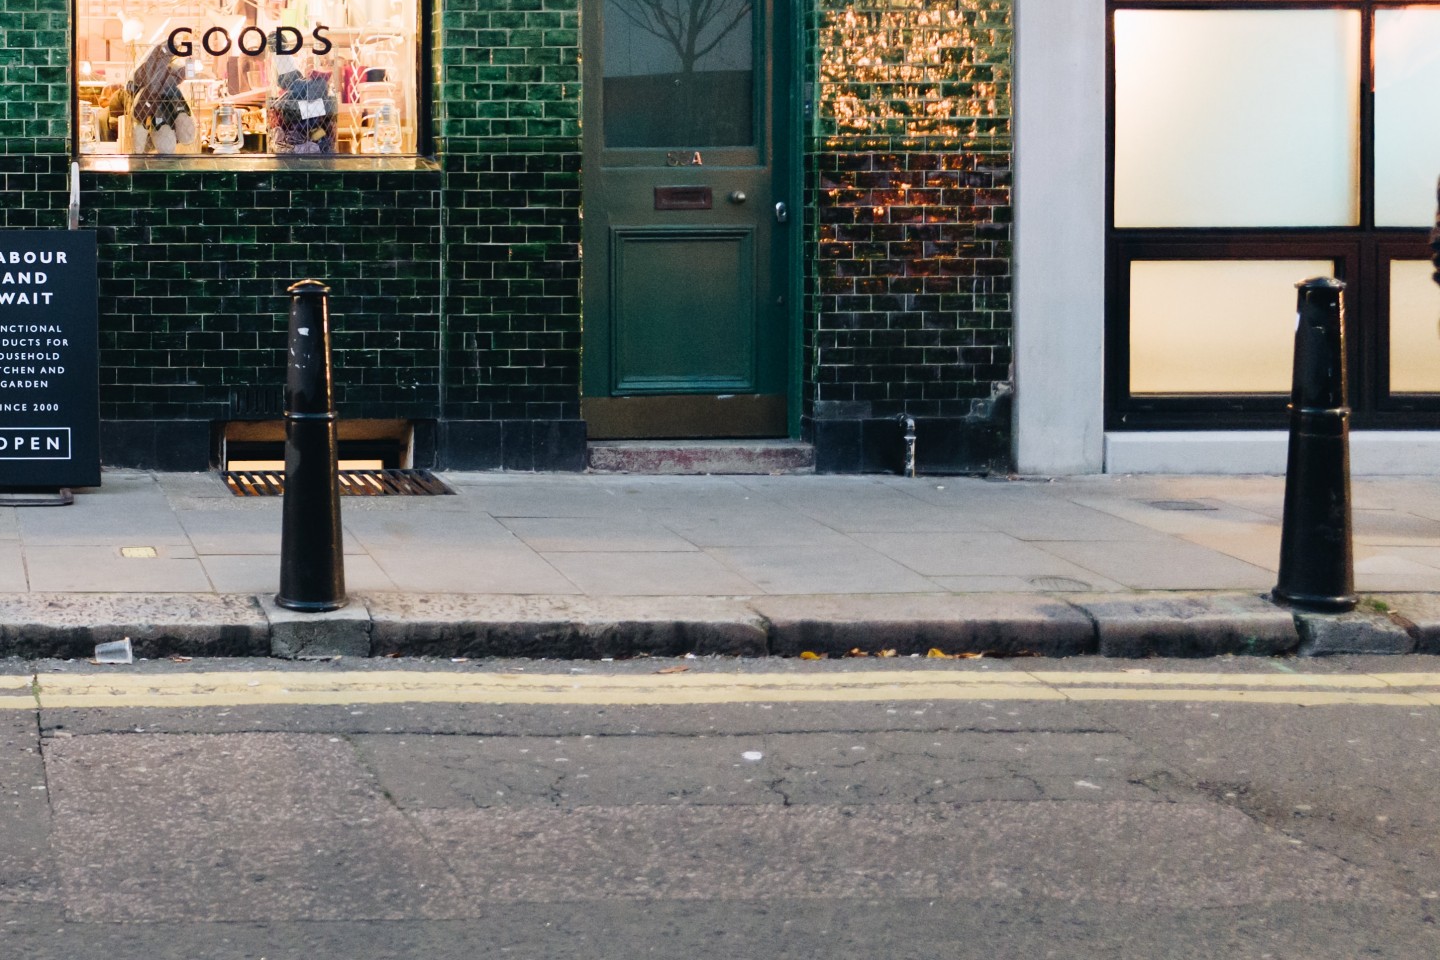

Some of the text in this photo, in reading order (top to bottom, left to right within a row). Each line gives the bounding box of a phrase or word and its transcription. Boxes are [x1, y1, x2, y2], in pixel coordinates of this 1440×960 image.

[167, 26, 333, 58] GOODS
[2, 271, 48, 285] AND
[46, 338, 69, 347] FOR
[40, 366, 65, 374] AND
[0, 380, 49, 388] GARDEN
[33, 403, 59, 412] 2000
